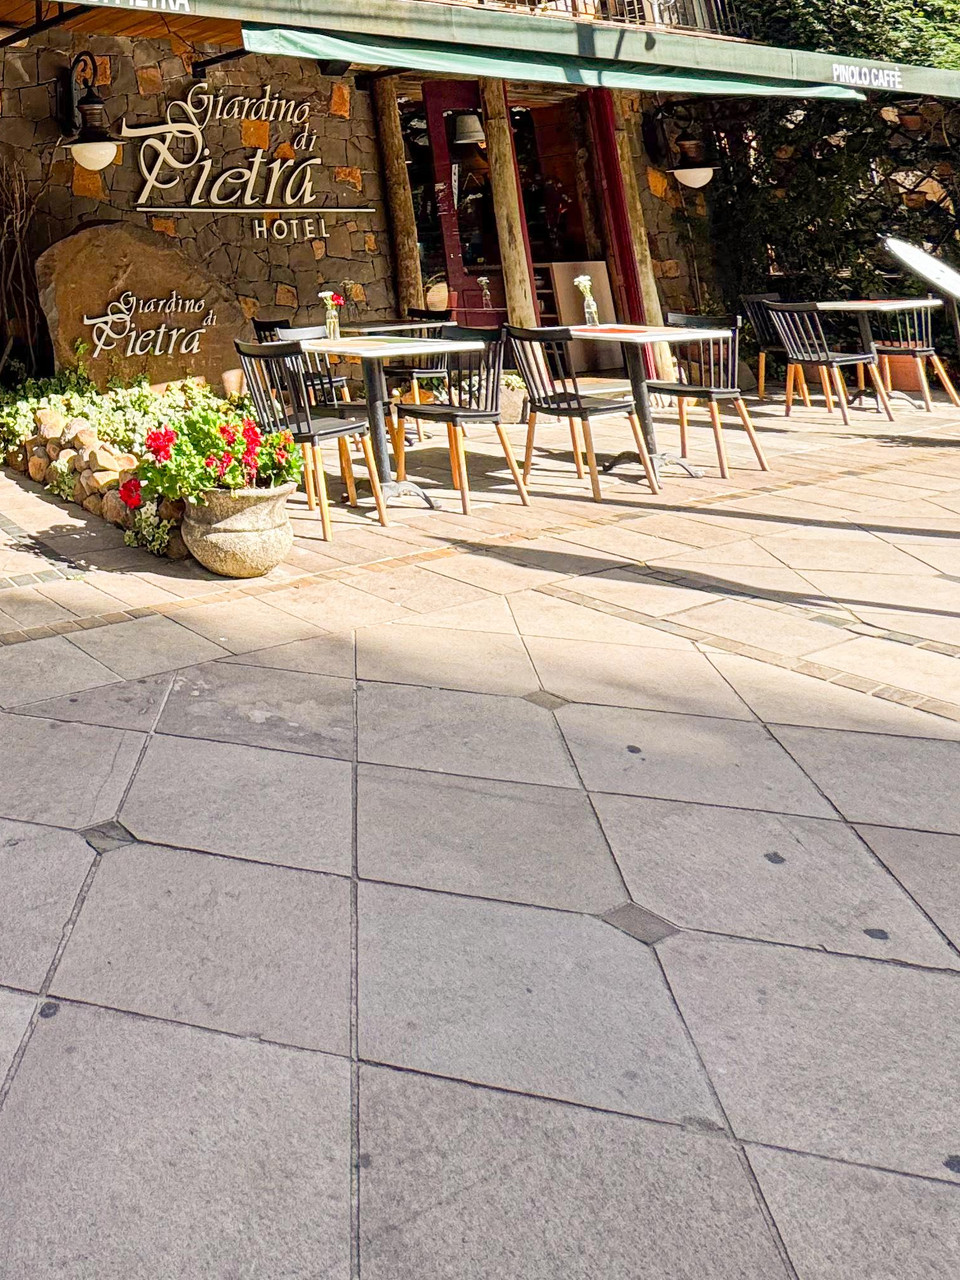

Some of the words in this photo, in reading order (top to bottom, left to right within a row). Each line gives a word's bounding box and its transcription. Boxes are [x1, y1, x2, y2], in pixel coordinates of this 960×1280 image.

[832, 63, 870, 86] PINOLO
[871, 67, 903, 89] CAFFÈ
[167, 82, 311, 132] Giardino
[293, 123, 317, 152] di
[121, 117, 322, 205] Pietra
[254, 218, 330, 239] HOTEL
[108, 290, 206, 321] Giardino
[202, 309, 217, 326] di
[83, 314, 207, 358] Pietra
